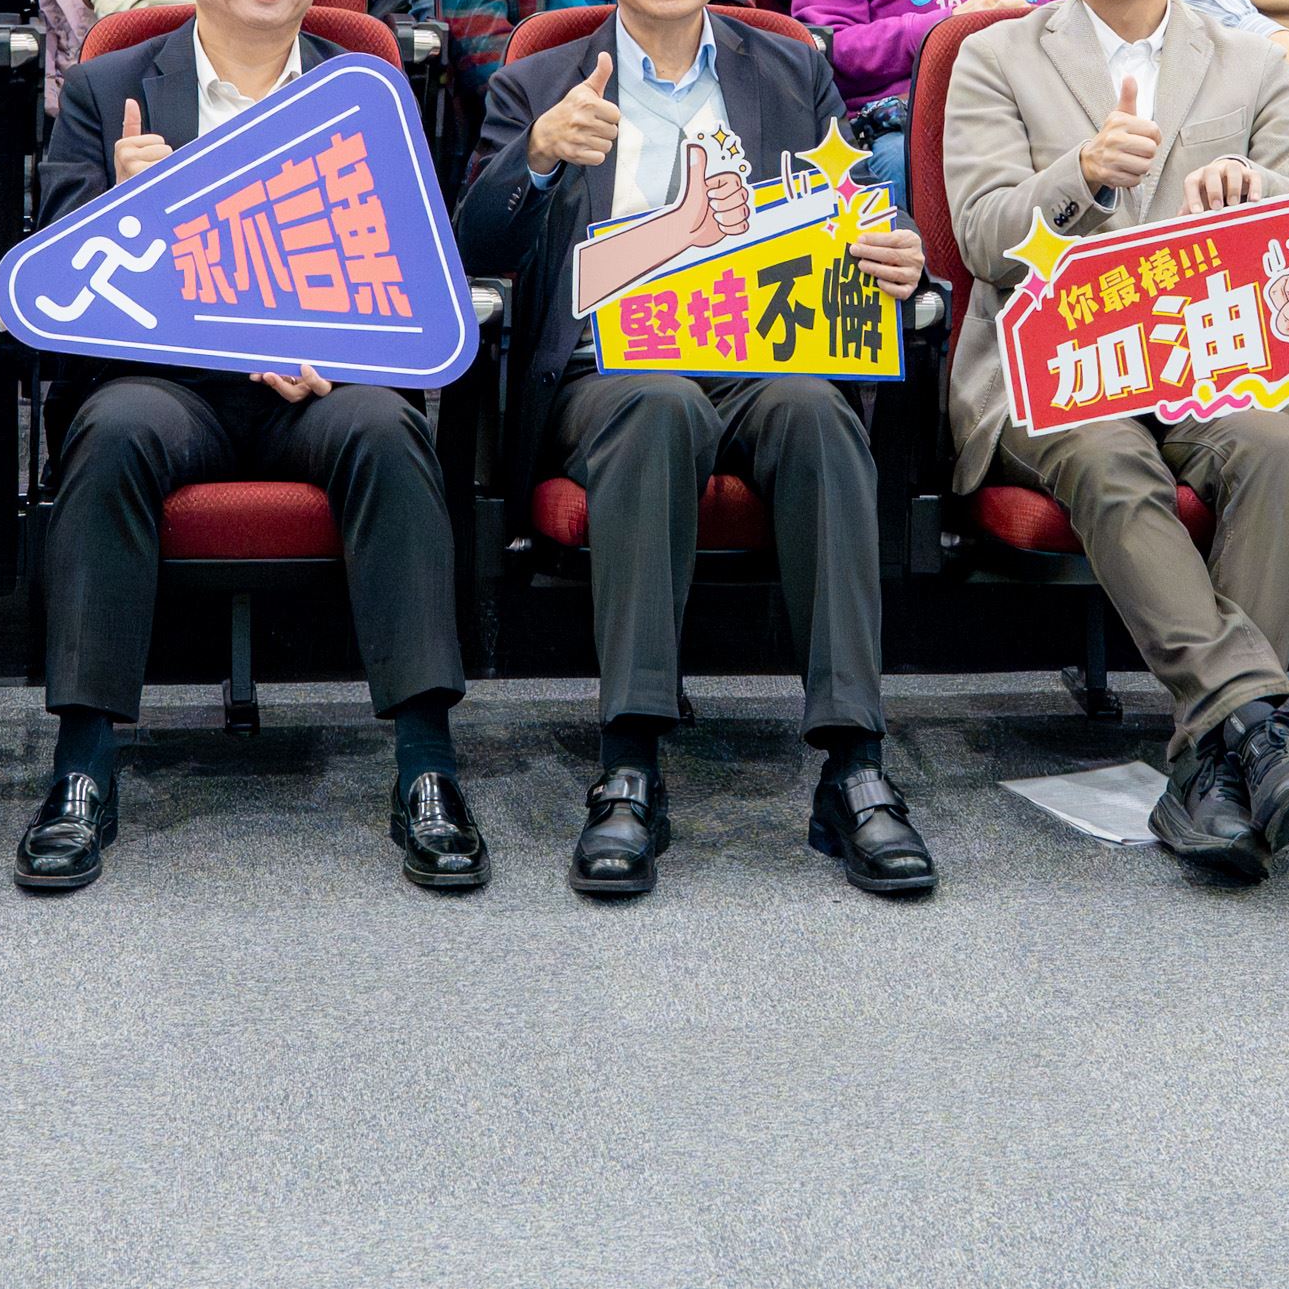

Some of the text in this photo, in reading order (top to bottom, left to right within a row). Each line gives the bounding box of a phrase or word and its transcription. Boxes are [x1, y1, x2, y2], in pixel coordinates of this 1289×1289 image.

[171, 132, 413, 318] 永不言棄
[1057, 238, 1221, 329] 你最棒!!!
[618, 239, 883, 363] 堅持不懈
[1048, 267, 1271, 410] 加油
